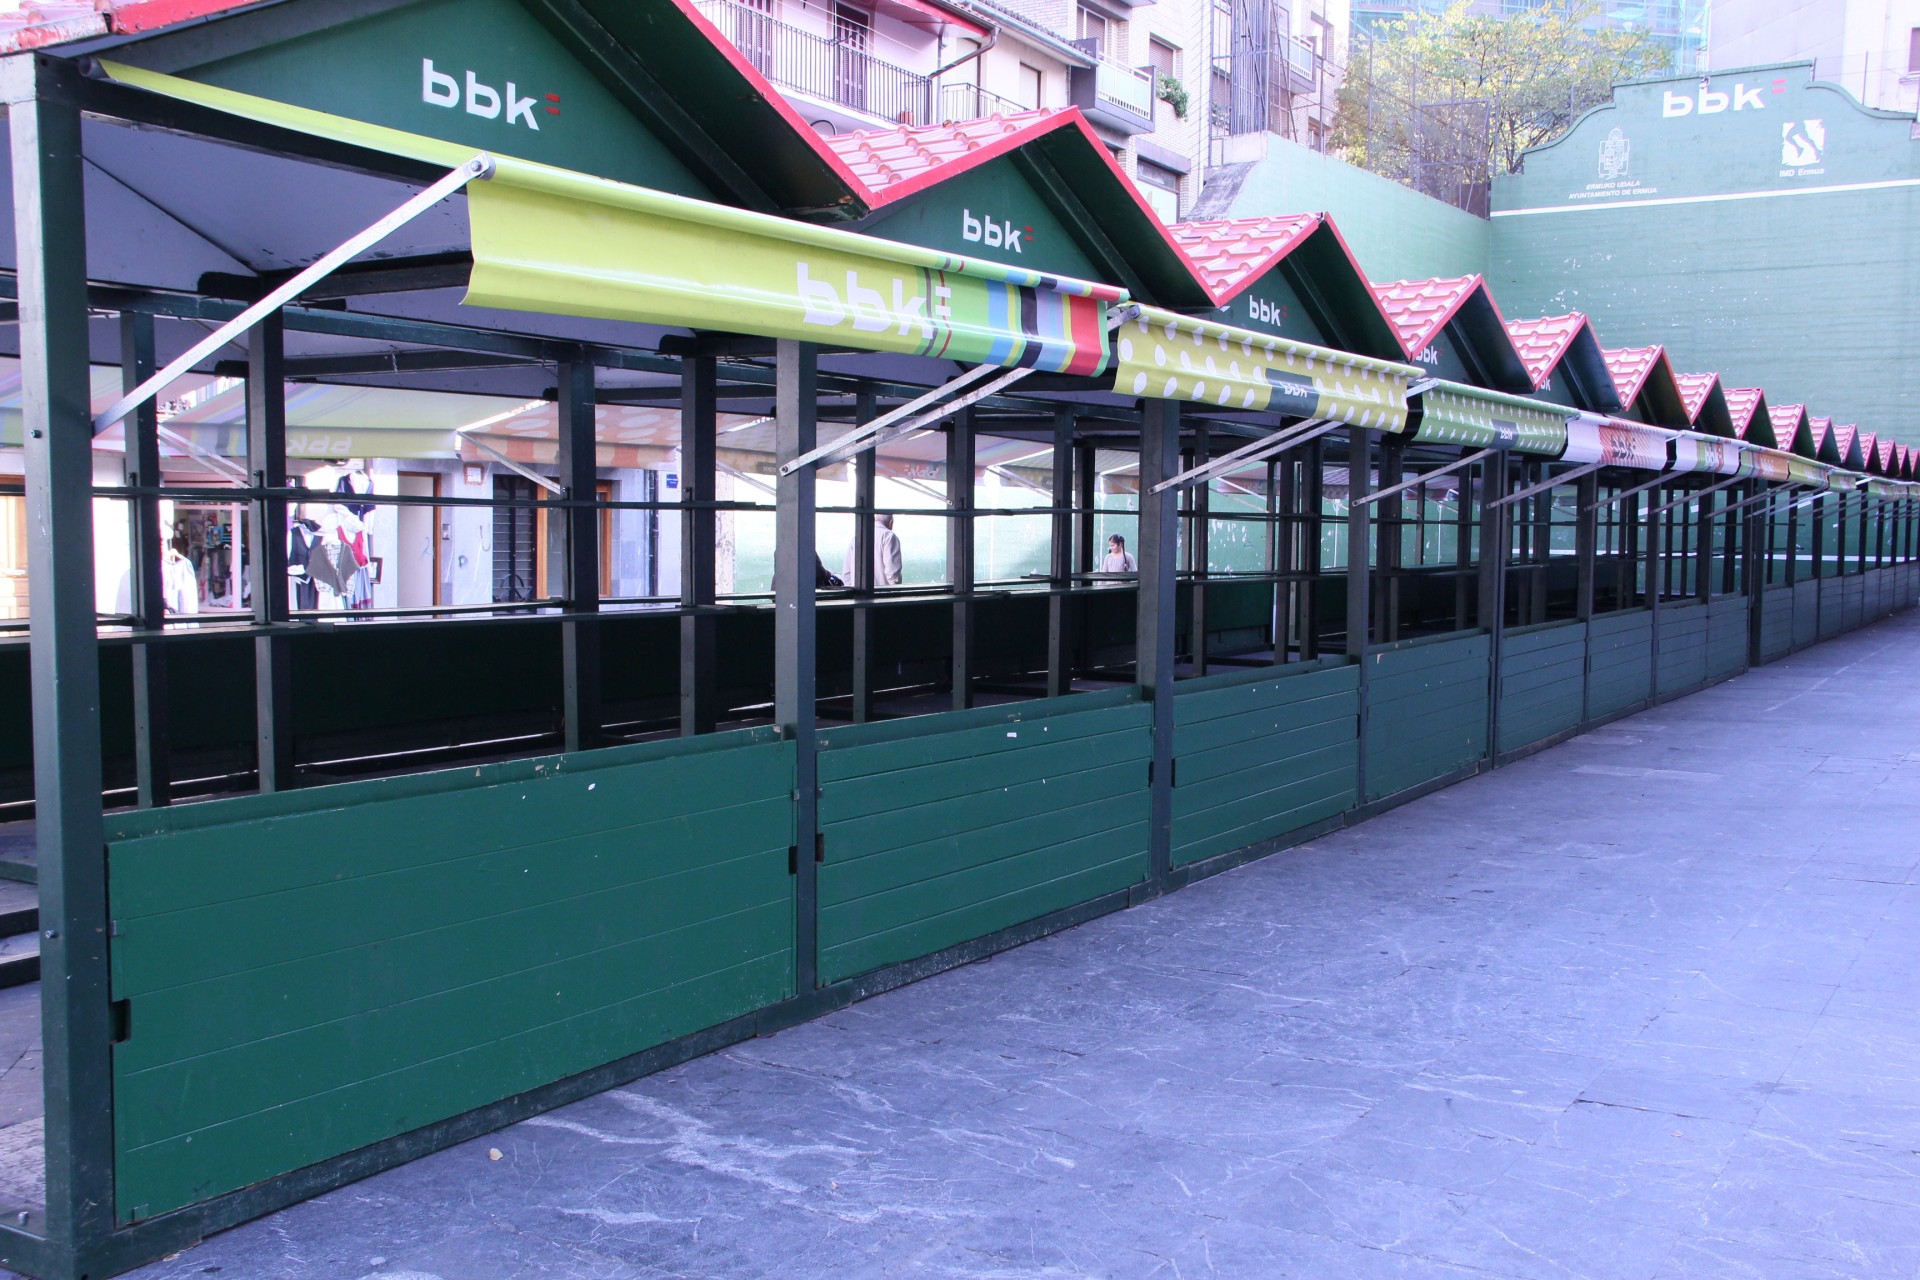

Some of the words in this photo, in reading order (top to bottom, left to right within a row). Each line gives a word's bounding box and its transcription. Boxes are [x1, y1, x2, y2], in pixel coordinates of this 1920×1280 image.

[423, 57, 540, 131] bbk
[1663, 83, 1765, 118] bbk
[1617, 180, 1640, 188] UDALA
[1779, 169, 1795, 178] IMD
[1798, 168, 1824, 176] Ermua
[1568, 190, 1620, 199] AYUNTAMIENTO
[1633, 187, 1657, 195] ERMUA
[963, 208, 1022, 253] bbk
[796, 262, 934, 340] bbk
[1249, 294, 1281, 327] bbk
